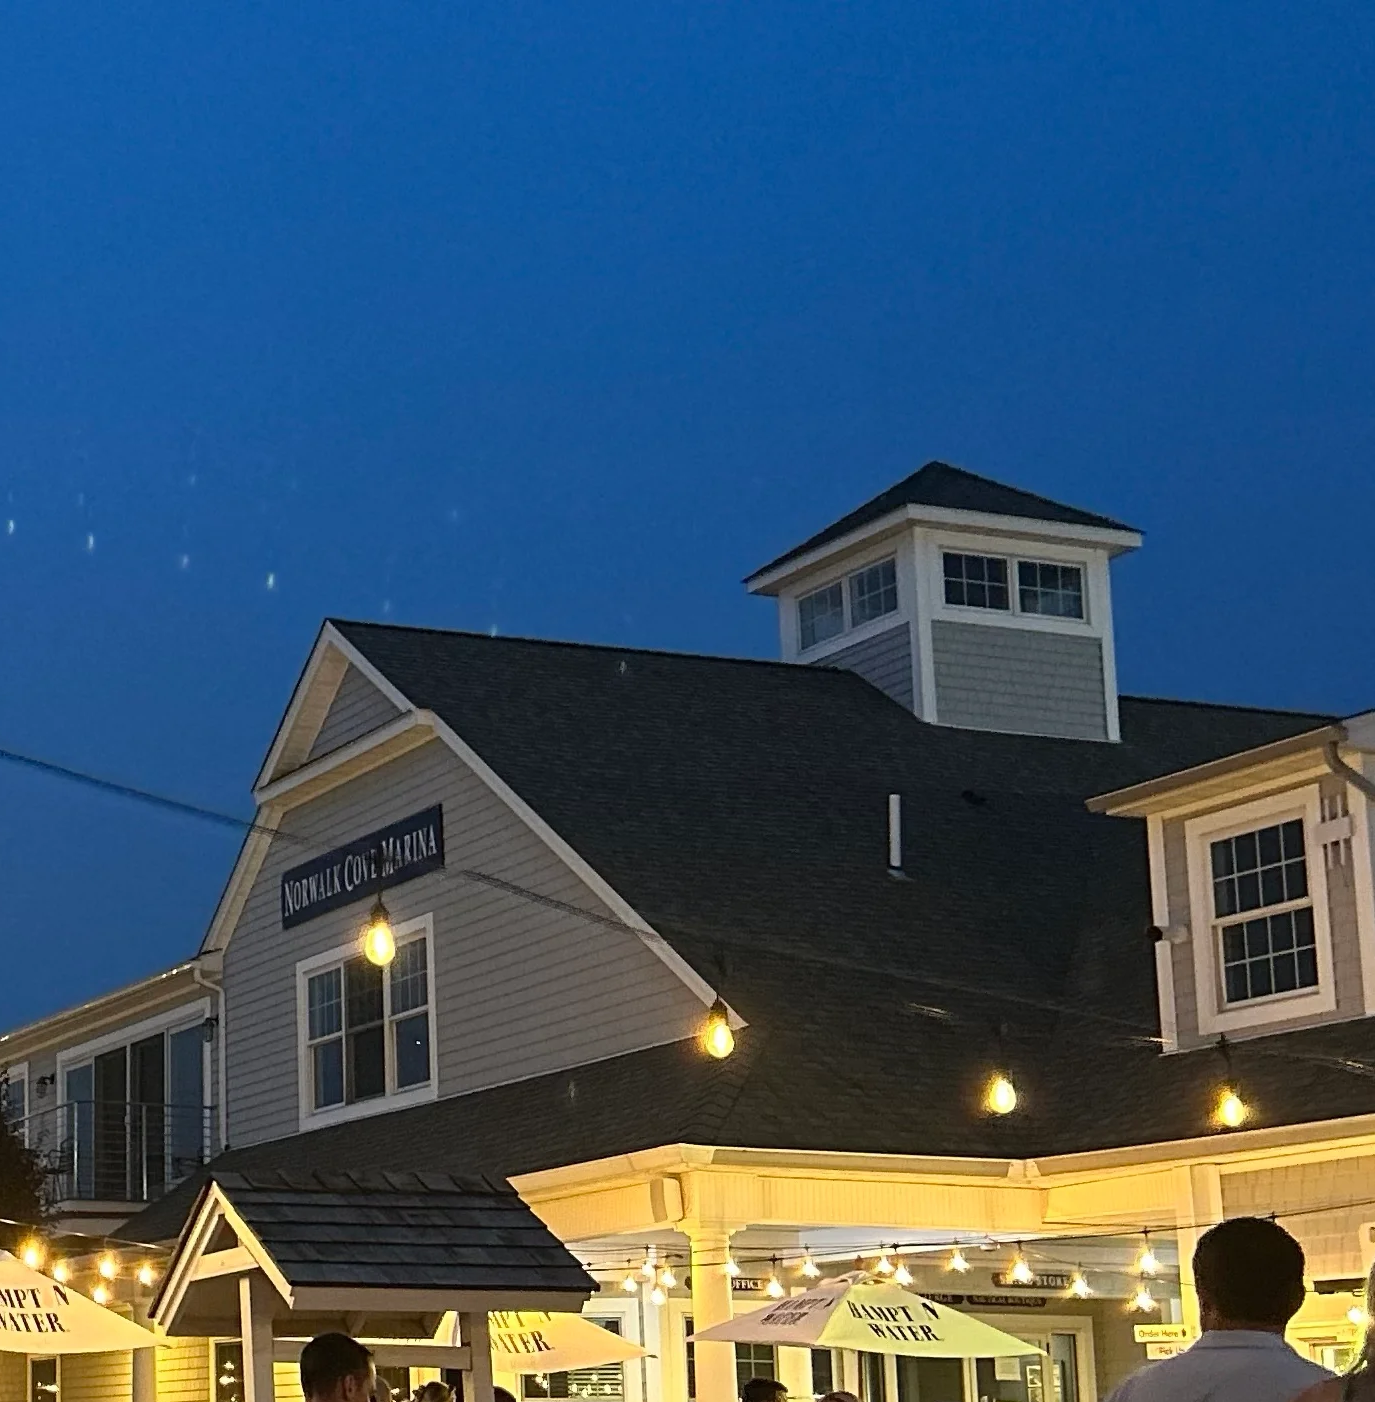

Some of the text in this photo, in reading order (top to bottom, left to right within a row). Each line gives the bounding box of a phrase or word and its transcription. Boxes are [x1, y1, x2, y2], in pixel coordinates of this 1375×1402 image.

[381, 823, 438, 877] MARINA
[846, 1299, 940, 1323] HAMPTN
[867, 1323, 944, 1342] WATER
